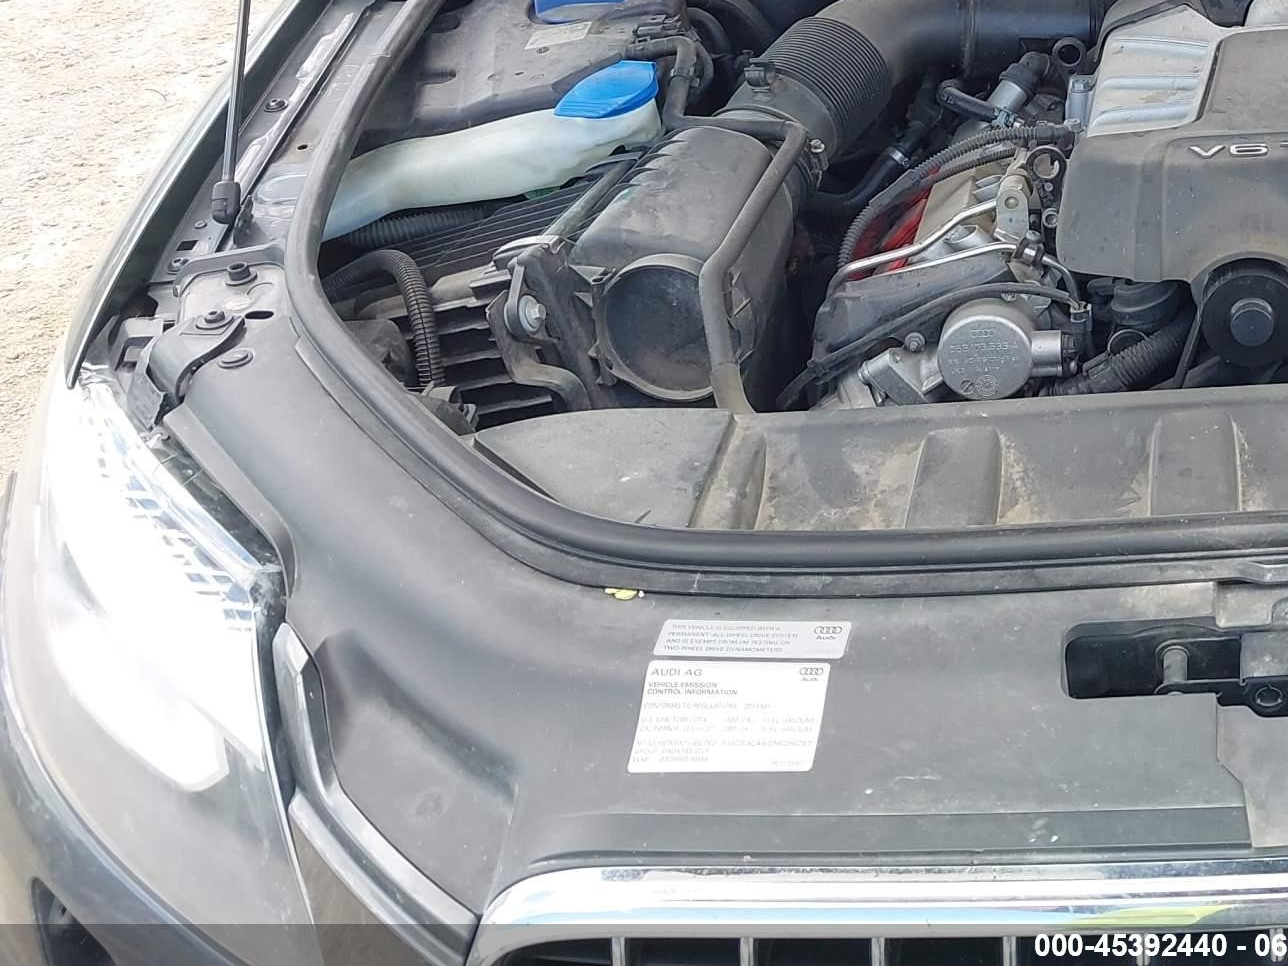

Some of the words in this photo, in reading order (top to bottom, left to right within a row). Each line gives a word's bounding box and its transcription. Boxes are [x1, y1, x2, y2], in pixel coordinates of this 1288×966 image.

[1188, 142, 1269, 159] V6
[650, 668, 681, 677] AUDI
[684, 668, 703, 677] AG
[681, 681, 718, 689] EMISSION
